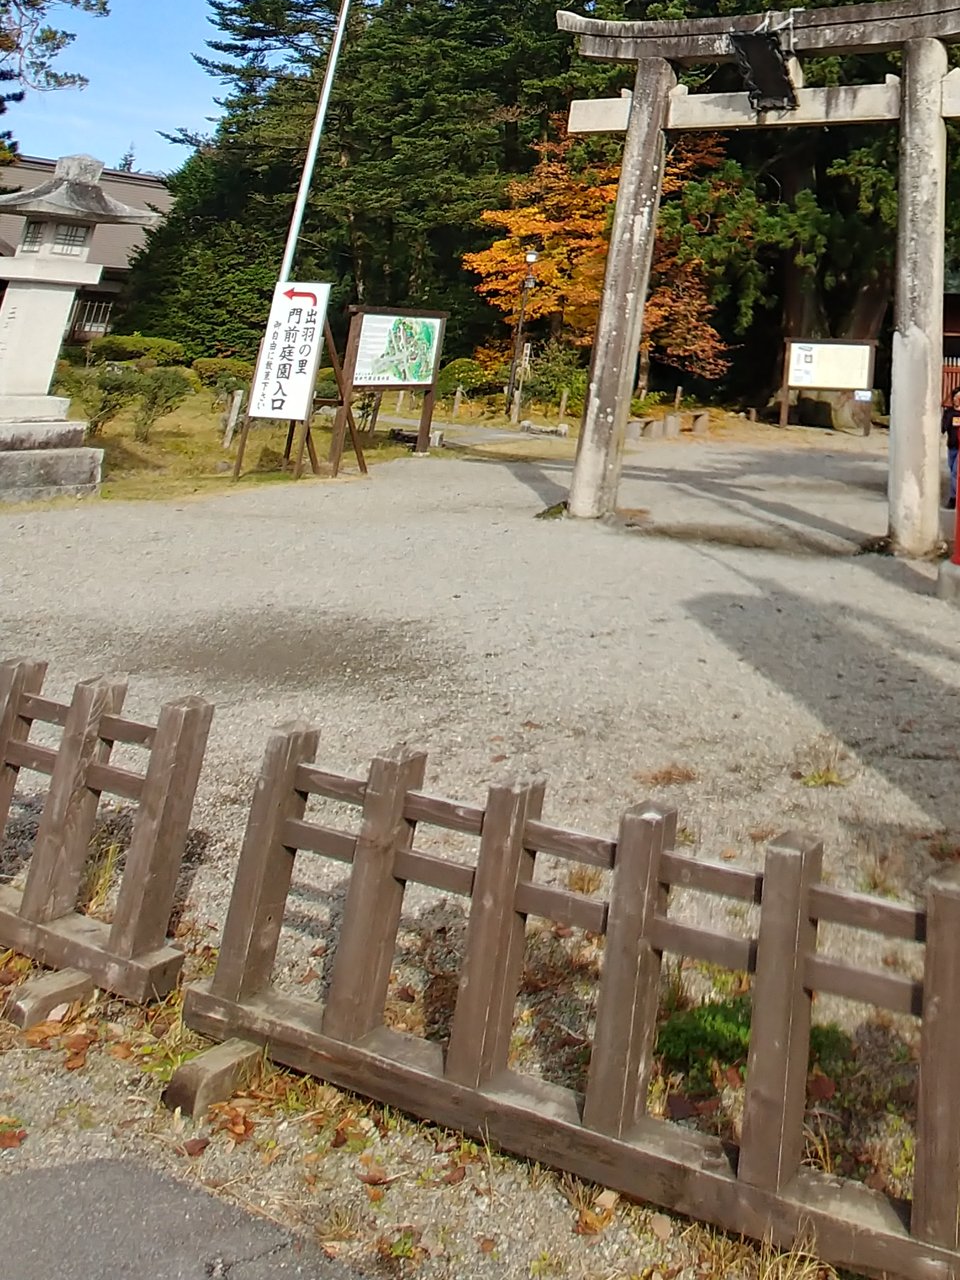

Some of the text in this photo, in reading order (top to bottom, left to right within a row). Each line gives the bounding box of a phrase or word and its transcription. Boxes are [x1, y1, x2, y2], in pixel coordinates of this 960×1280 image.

[270, 307, 304, 411] 門前庭園入口
[295, 307, 318, 376] 出羽の里
